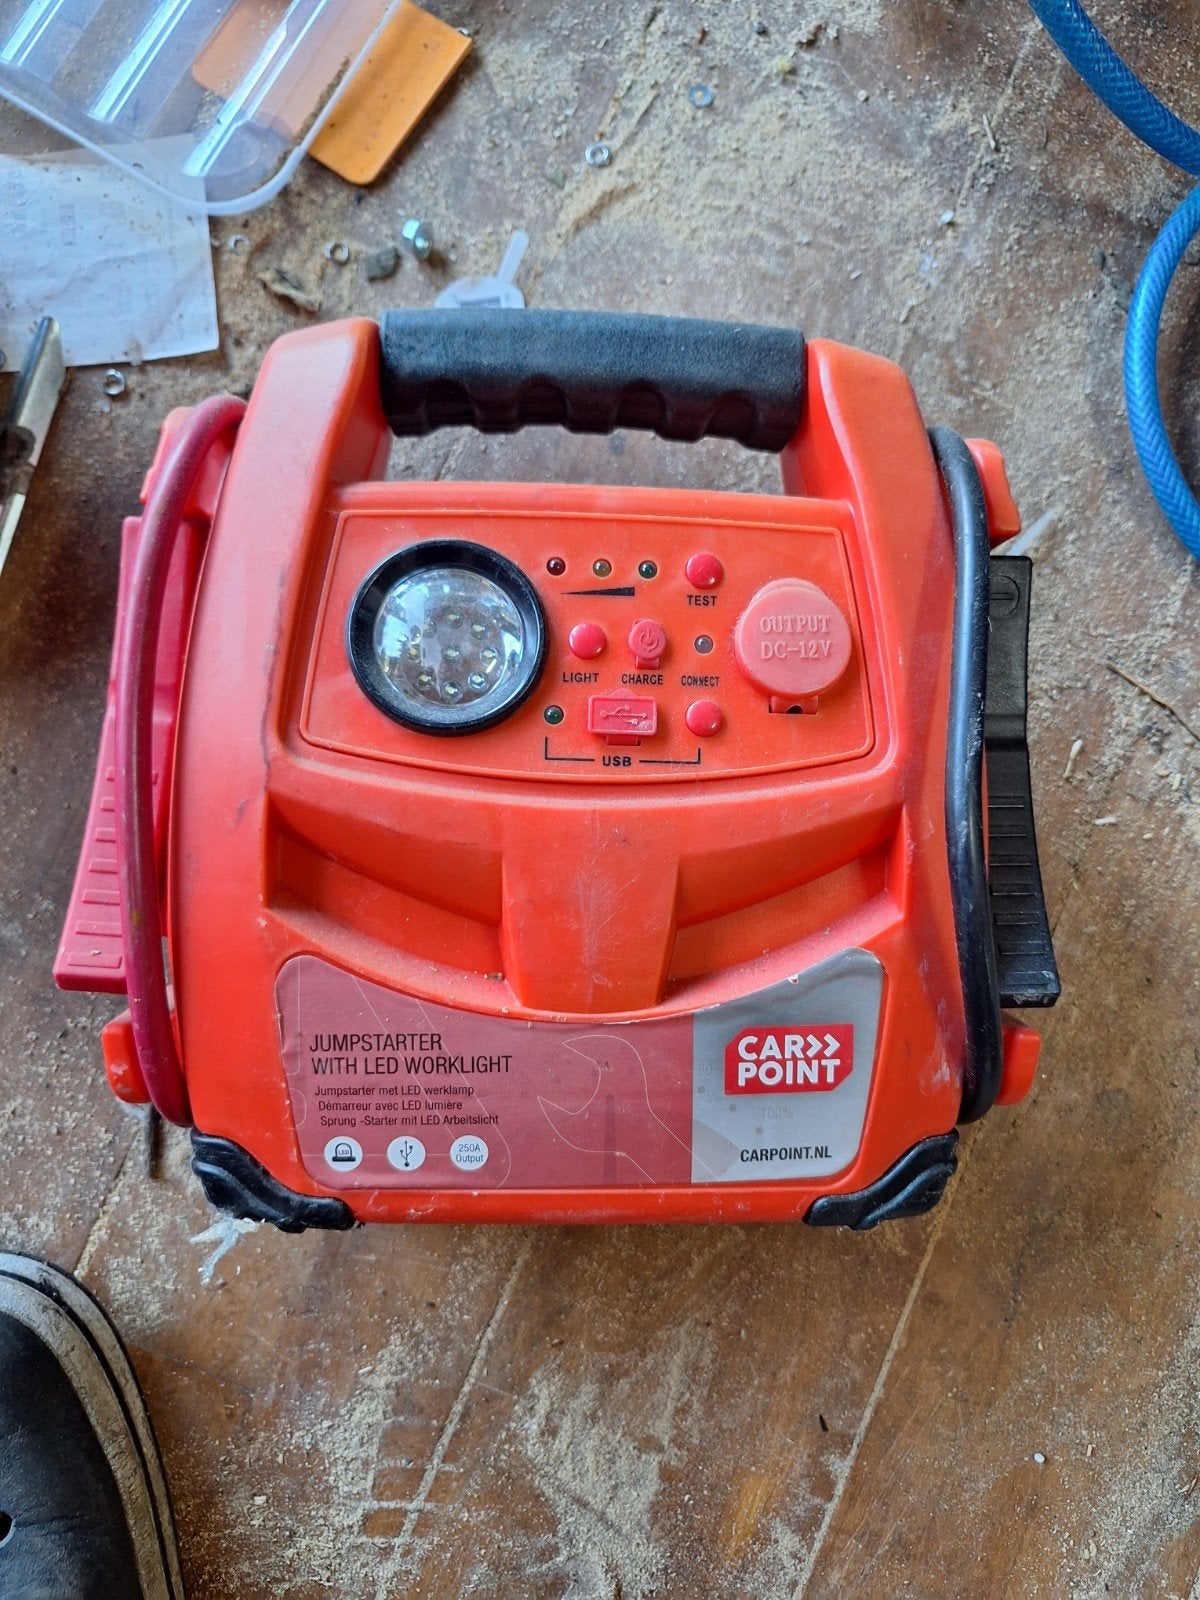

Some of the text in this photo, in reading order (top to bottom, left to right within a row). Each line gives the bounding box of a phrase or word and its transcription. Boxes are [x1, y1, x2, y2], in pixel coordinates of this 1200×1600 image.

[687, 594, 717, 607] TEST
[760, 614, 831, 634] OUTPUT
[760, 640, 833, 660] DC-12V
[562, 672, 599, 684] LIGHT
[621, 673, 663, 686] CHARGE
[681, 675, 720, 687] CONNECT
[602, 756, 632, 768] USB
[310, 1033, 442, 1052] JUMPSTARTER
[738, 1034, 805, 1060] CAR
[311, 1055, 512, 1075] WITH LED WORKLIGHT
[738, 1058, 841, 1087] POINT
[315, 1085, 474, 1097] Jumpstarter met LED werklamp
[318, 1100, 463, 1111] Démarreur avec LED lumière
[321, 1116, 357, 1127] Sprung
[401, 1115, 417, 1125] mit
[421, 1115, 440, 1125] LED
[442, 1115, 499, 1125] Arbeitslicht
[458, 1144, 481, 1153] 250A
[740, 1146, 832, 1162] CARPOINT.NL
[456, 1153, 484, 1164] Output
